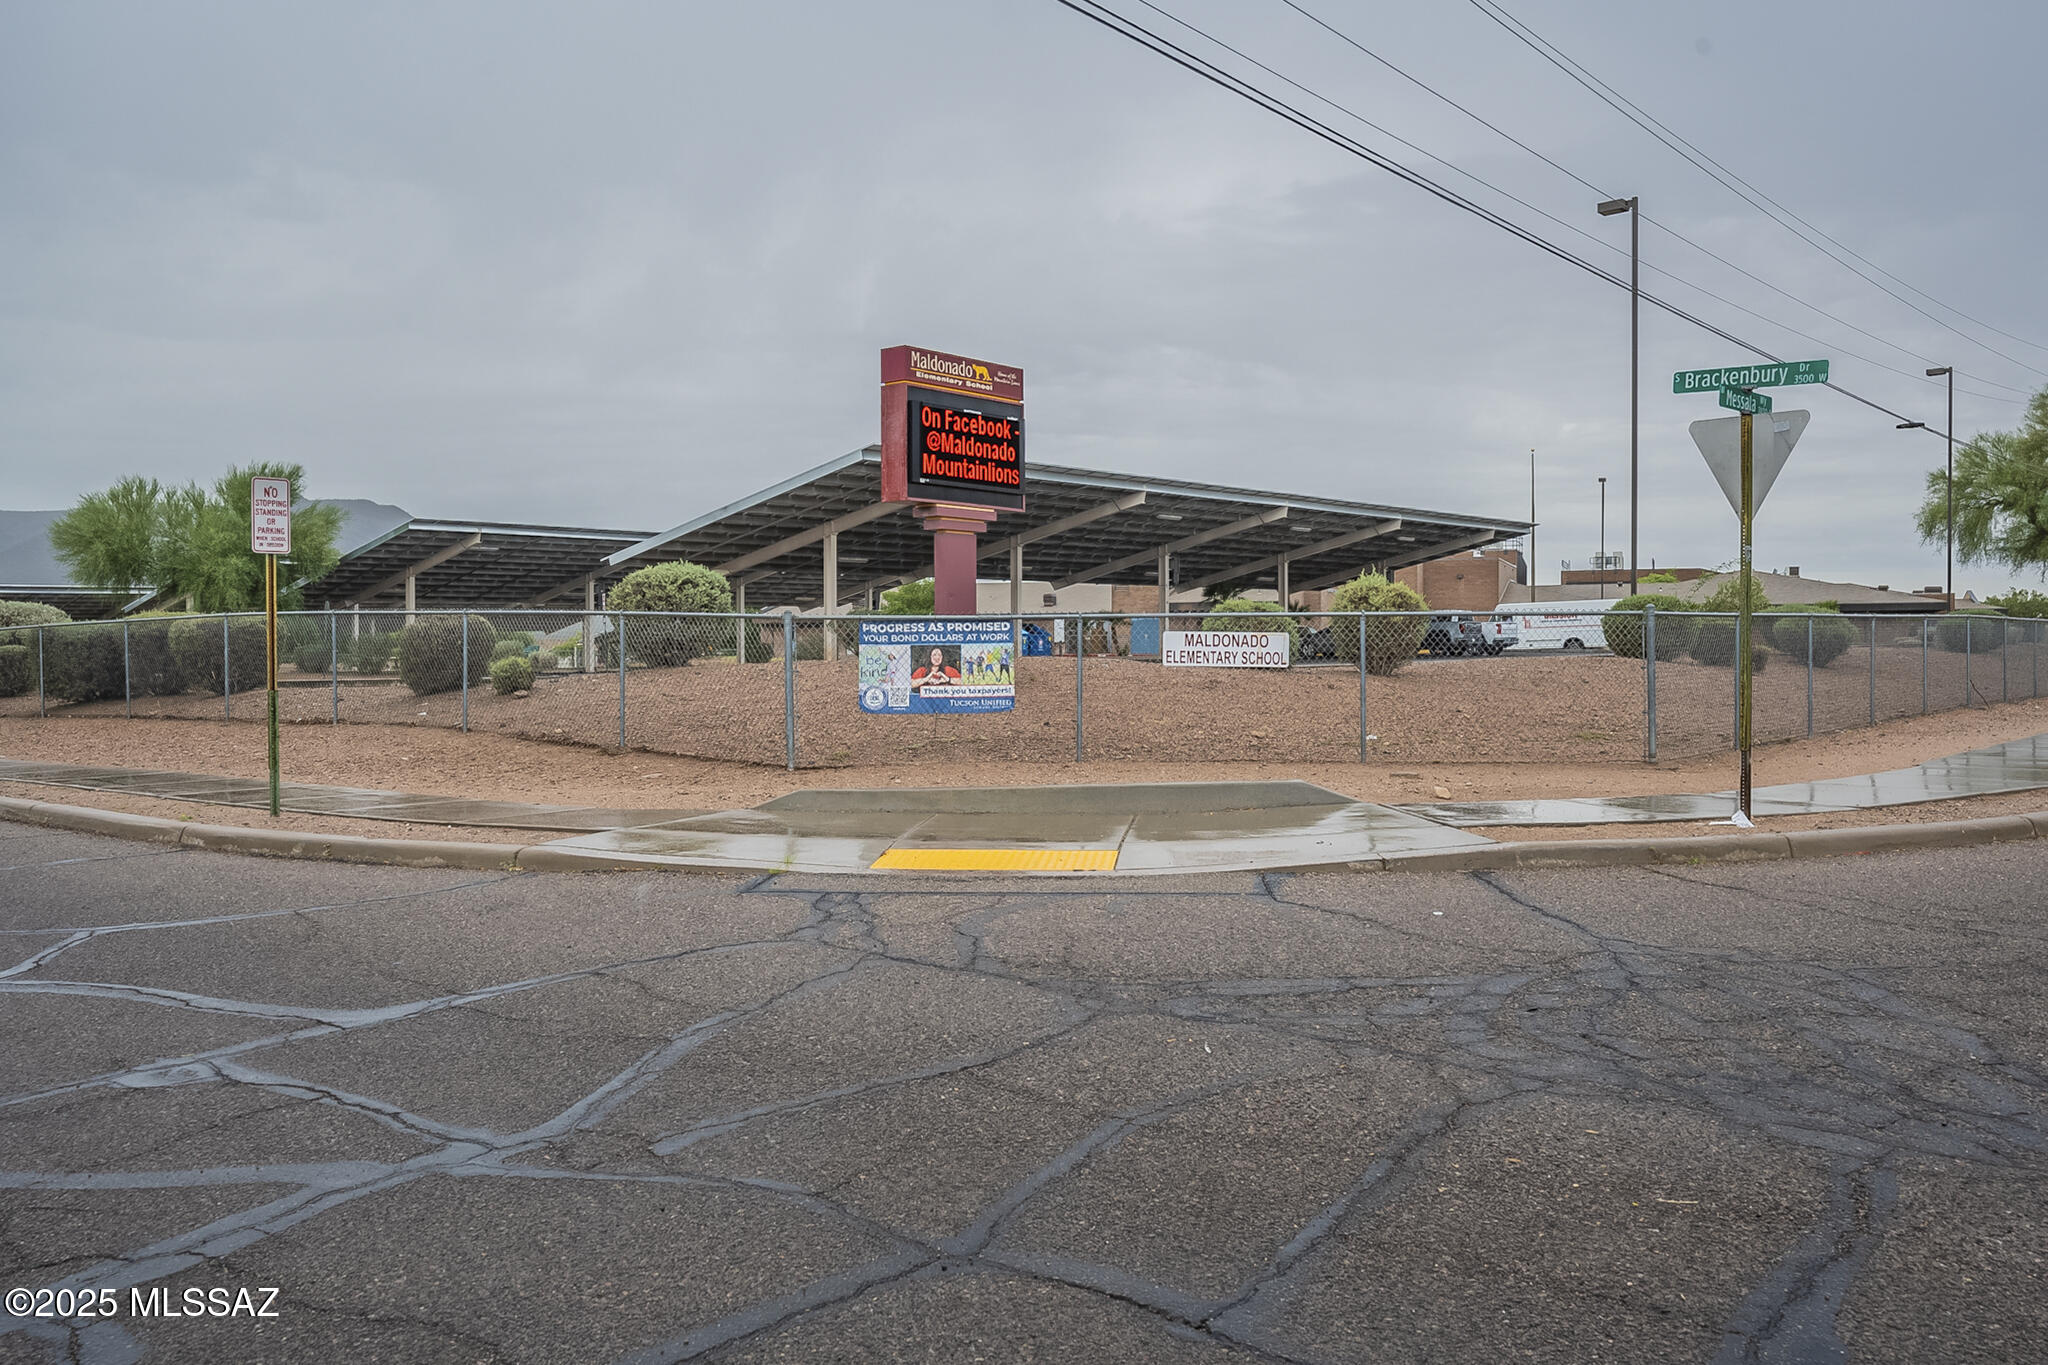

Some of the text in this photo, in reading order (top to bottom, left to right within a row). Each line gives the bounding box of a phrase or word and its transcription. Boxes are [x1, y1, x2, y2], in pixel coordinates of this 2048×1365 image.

[911, 351, 973, 377] Maldonado
[916, 371, 963, 386] Elementary
[966, 380, 993, 391] School
[1675, 363, 1810, 388] S Brackenbury Dr
[1794, 373, 1828, 384] 3500 W
[1726, 389, 1756, 412] Messala
[922, 406, 941, 428] On
[945, 409, 1012, 439] Facebook
[927, 431, 1015, 462] @Maldonado
[922, 453, 1020, 485] Mountainlions
[264, 487, 278, 498] NO
[256, 499, 287, 508] STOPPING
[862, 622, 1010, 633] PROGRESS AS PROMISED
[863, 635, 889, 643] YOUR
[891, 634, 919, 642] BOND
[921, 634, 964, 642] DOLLARS
[980, 633, 1010, 641] WORK
[1184, 634, 1269, 648] MALDONADO
[866, 655, 882, 665] be
[1166, 650, 1287, 665] ELEMENTARY SCHOOL
[860, 665, 888, 678] kind
[952, 688, 966, 696] you
[969, 687, 1012, 696] taxpayers!
